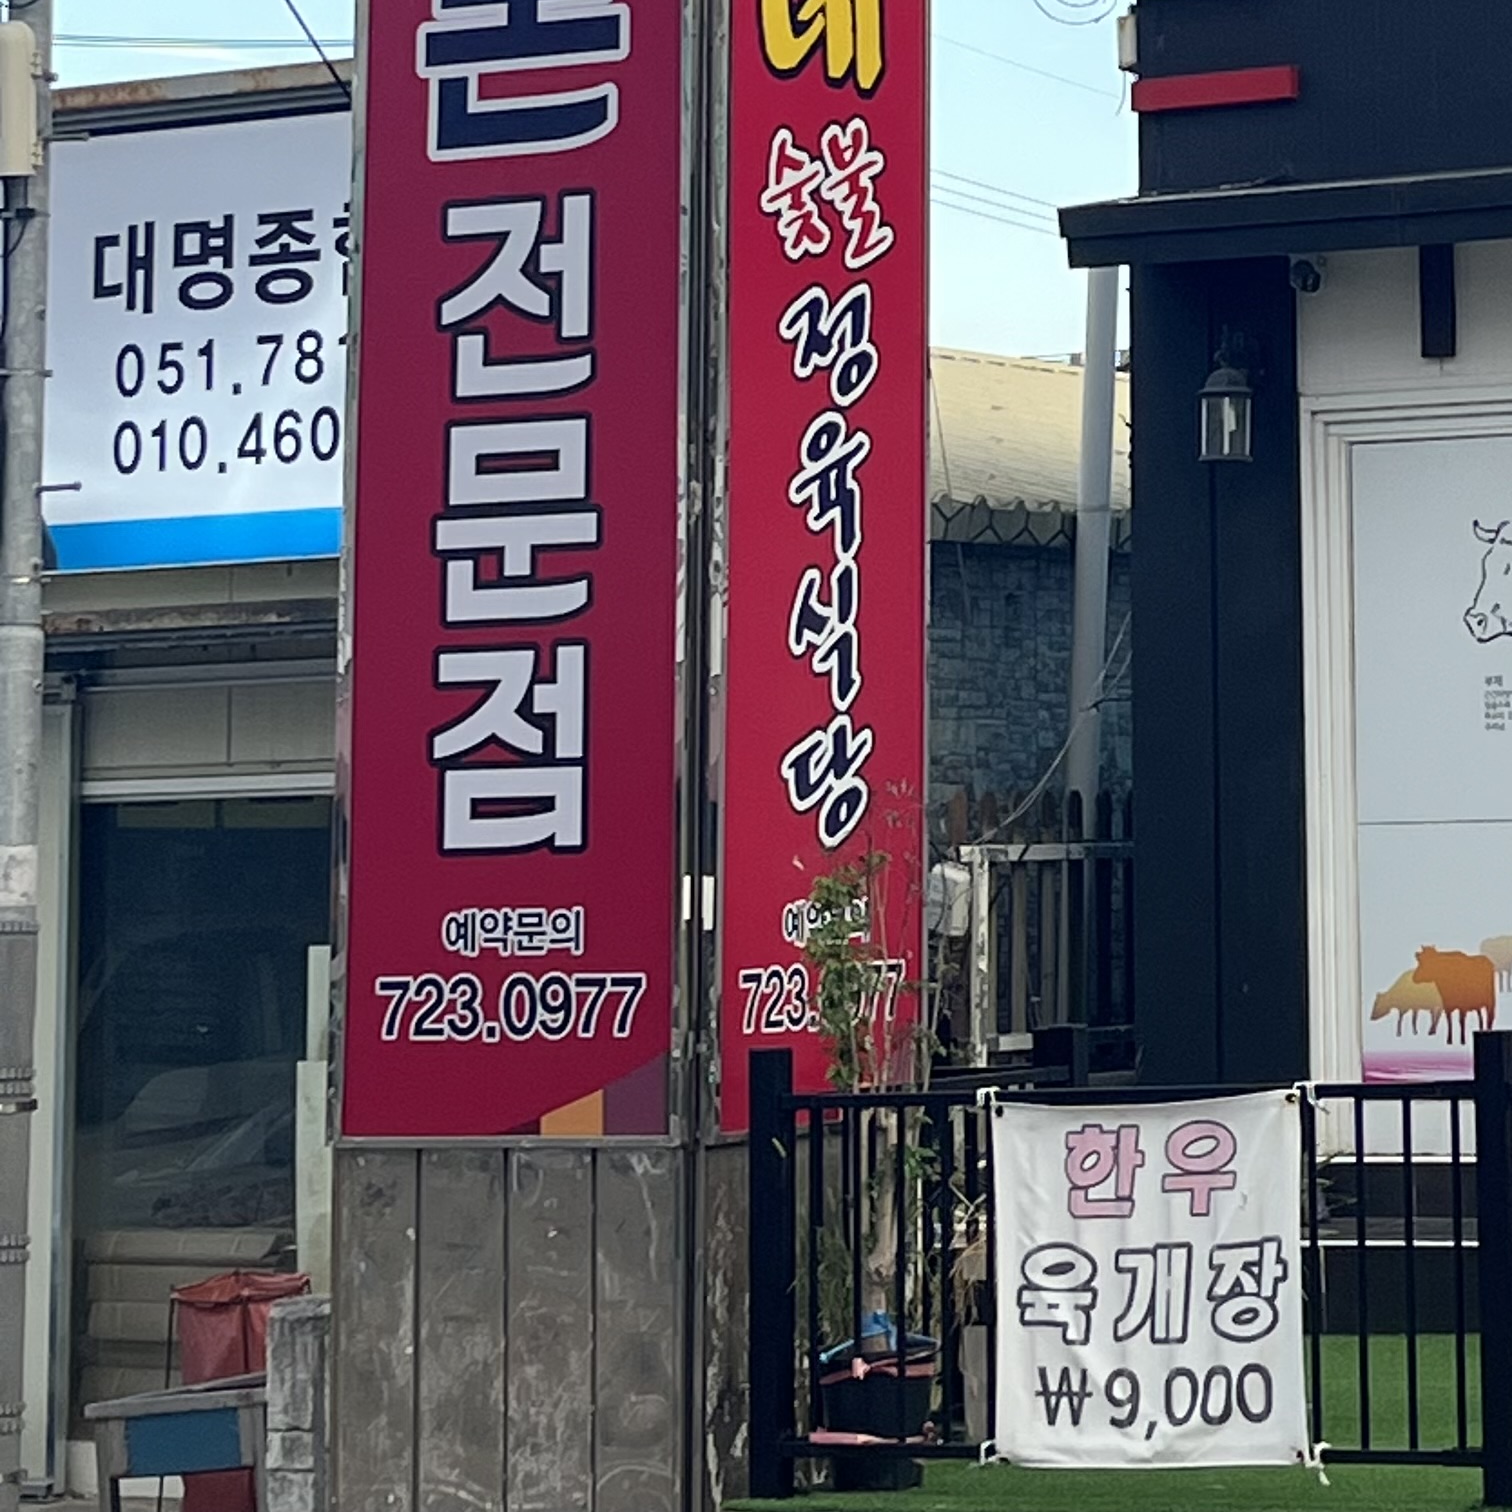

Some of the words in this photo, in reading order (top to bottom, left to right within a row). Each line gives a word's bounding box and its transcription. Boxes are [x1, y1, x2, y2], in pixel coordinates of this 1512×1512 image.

[758, 115, 896, 271] 숯불
[112, 405, 341, 476] 010.460
[427, 186, 602, 856] 전문점
[776, 281, 881, 850] 정육식당
[442, 908, 584, 956] 예약문의
[376, 974, 647, 1042] 723.0977
[739, 958, 906, 1033] 723.77
[1064, 1119, 1237, 1219] 한우
[1016, 1235, 1289, 1345] 육개장
[1035, 1362, 1274, 1441] ₩9,000
